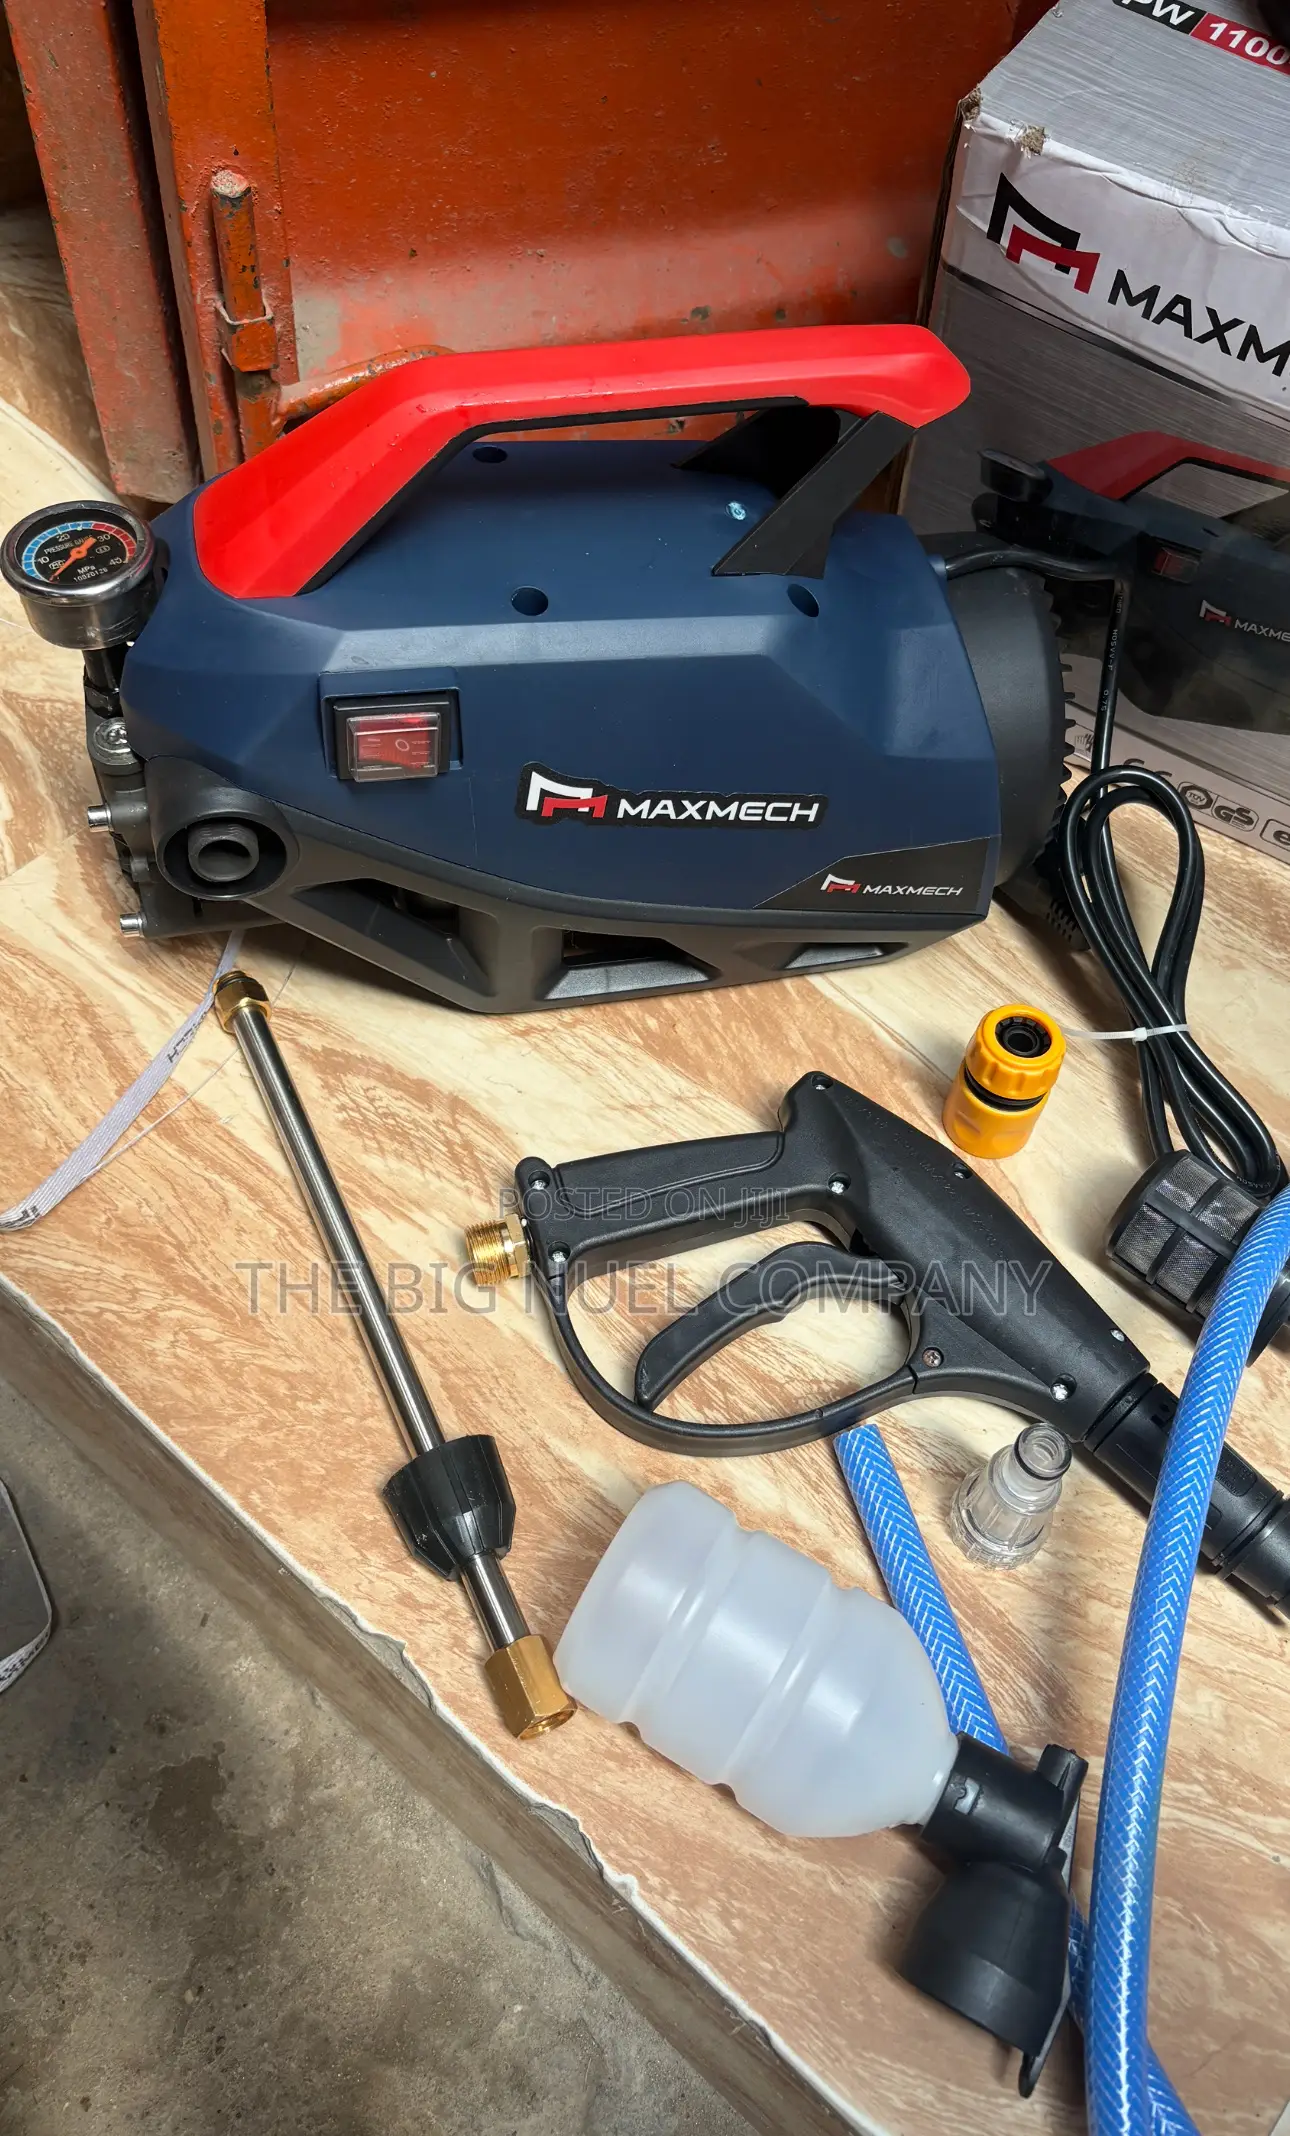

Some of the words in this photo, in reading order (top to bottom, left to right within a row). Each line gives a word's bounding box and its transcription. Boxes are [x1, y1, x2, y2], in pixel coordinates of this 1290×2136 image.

[1107, 269, 1290, 377] MAXM
[56, 533, 70, 542] 20
[97, 533, 111, 543] 30
[37, 556, 50, 565] 10
[109, 557, 123, 566] 40
[77, 565, 96, 575] MPa
[617, 799, 820, 823] MAXMECH
[1214, 804, 1255, 826] GS
[862, 884, 964, 897] MAXMECH
